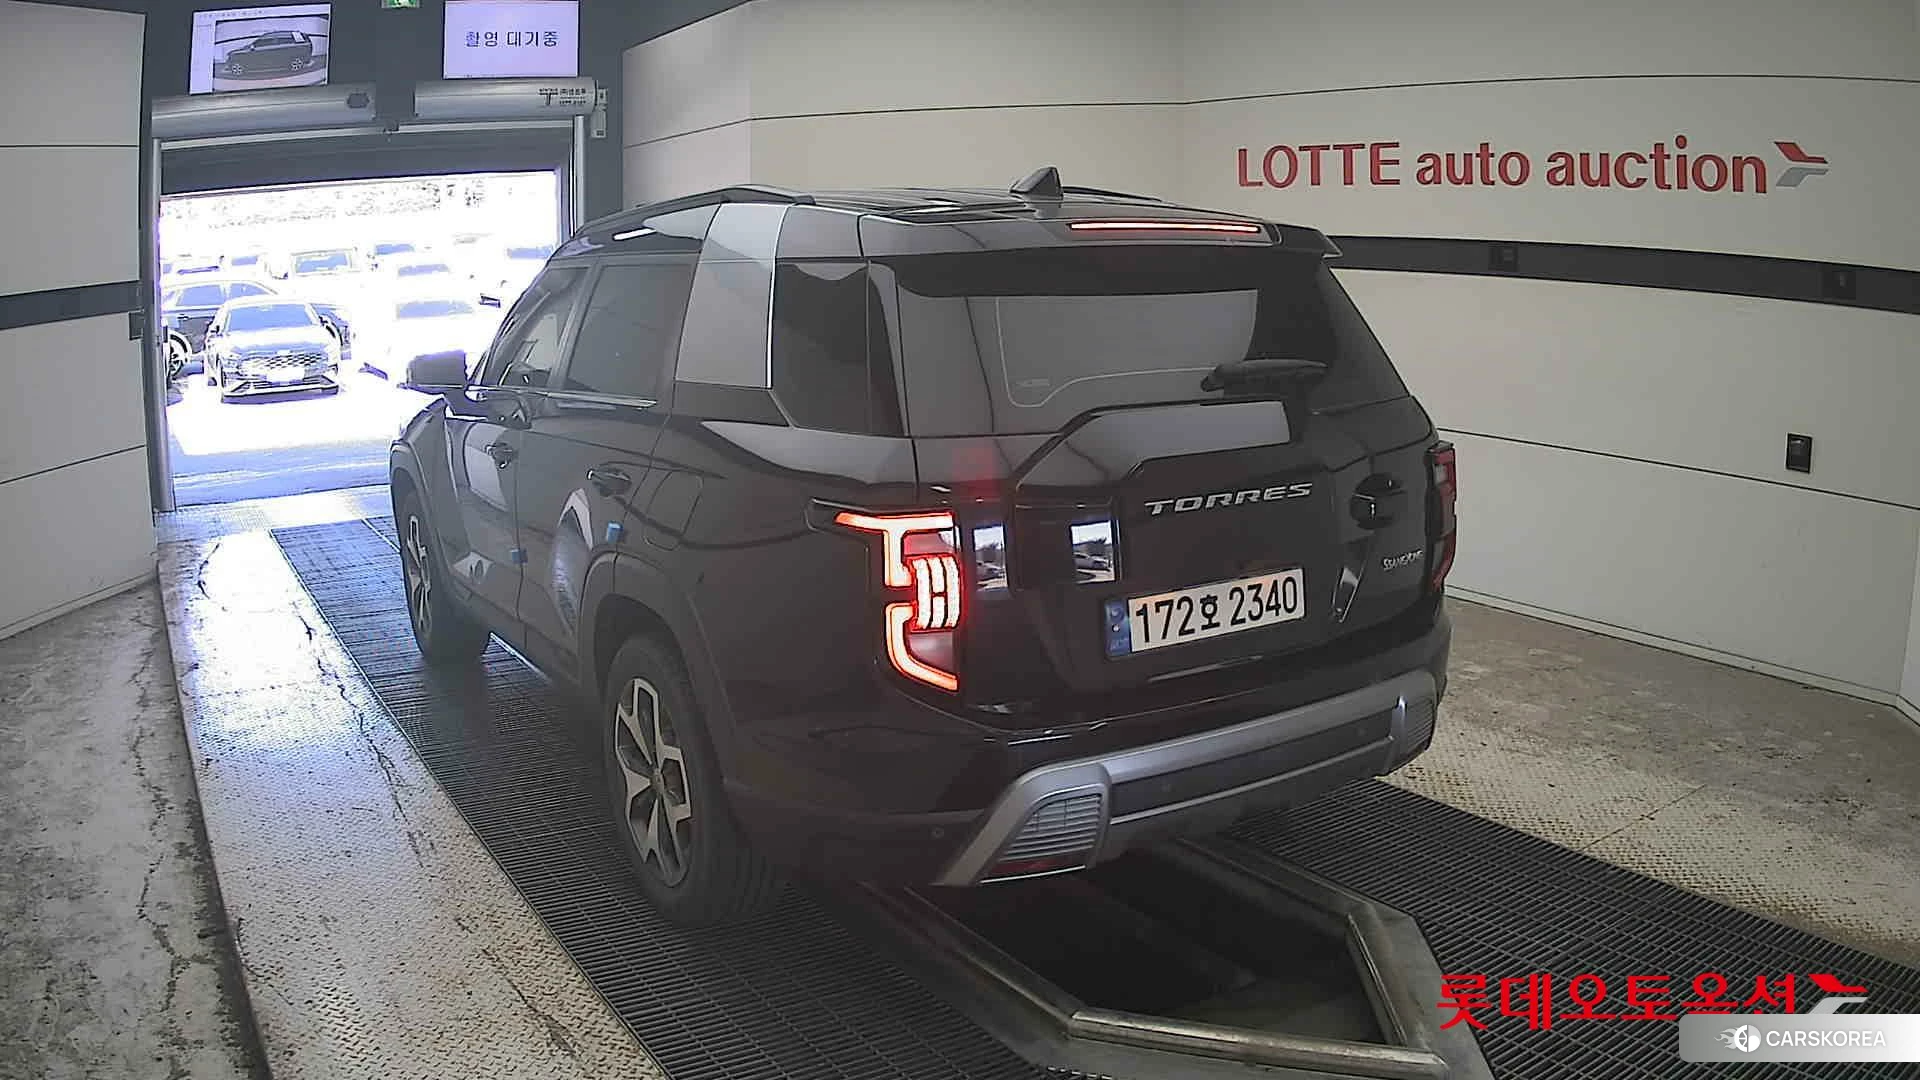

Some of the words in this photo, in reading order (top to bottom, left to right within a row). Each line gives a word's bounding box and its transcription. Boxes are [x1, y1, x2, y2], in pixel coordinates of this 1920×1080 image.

[506, 31, 557, 47] 대기중
[1239, 142, 1400, 188] LOTTE
[1416, 142, 1530, 187] auto
[1547, 135, 1768, 194] auction
[1145, 483, 1313, 515] TORRES
[1135, 594, 1220, 644] 172호
[1228, 576, 1299, 626] 2340
